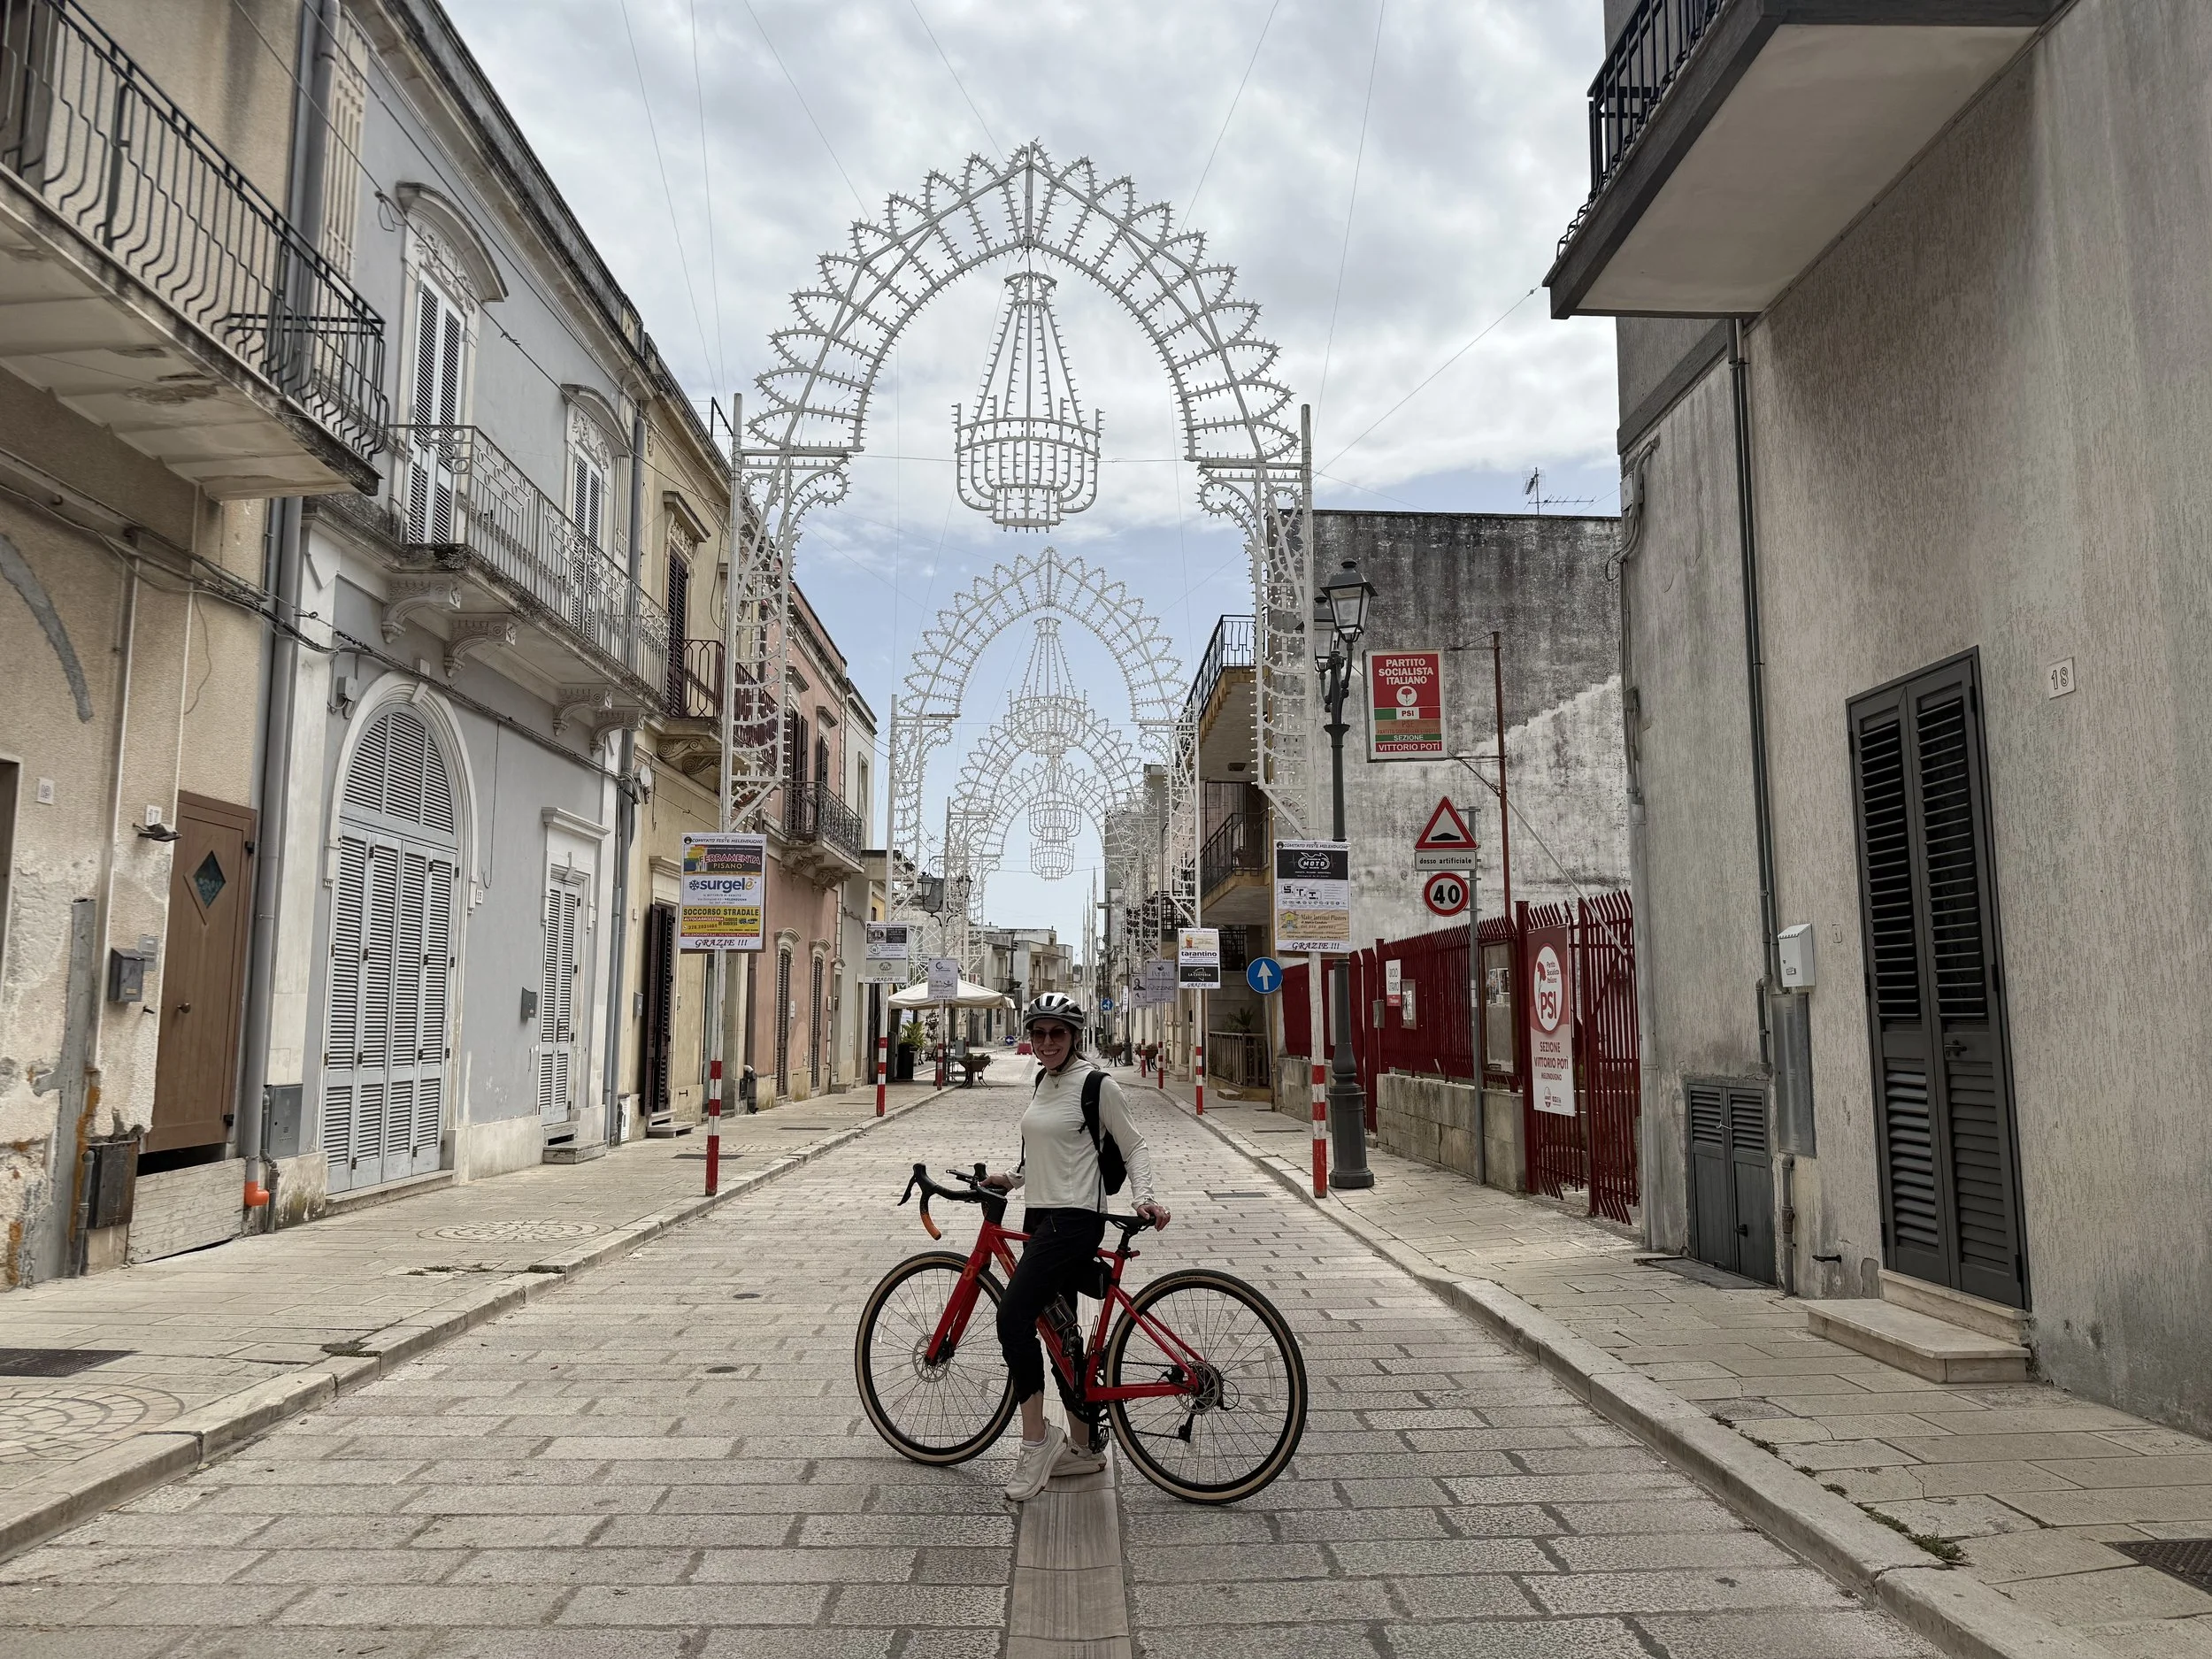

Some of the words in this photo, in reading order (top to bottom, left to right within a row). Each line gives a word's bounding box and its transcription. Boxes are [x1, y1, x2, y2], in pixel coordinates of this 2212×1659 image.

[1386, 658, 1425, 667] PARTITO
[1379, 667, 1433, 676] SOCIALISTA
[1386, 676, 1427, 685] ITALIANO
[2051, 667, 2069, 690] 18
[699, 853, 761, 864] FERRAMENTA
[1433, 885, 1460, 904] 40
[695, 939, 735, 949] GRAZIE
[1292, 941, 1328, 950] GRAZIE
[1540, 991, 1557, 1019] PSI
[1540, 1041, 1561, 1053] SEZIONE
[1533, 1056, 1555, 1068] VITTORIO
[1556, 1056, 1569, 1070] POTÌ
